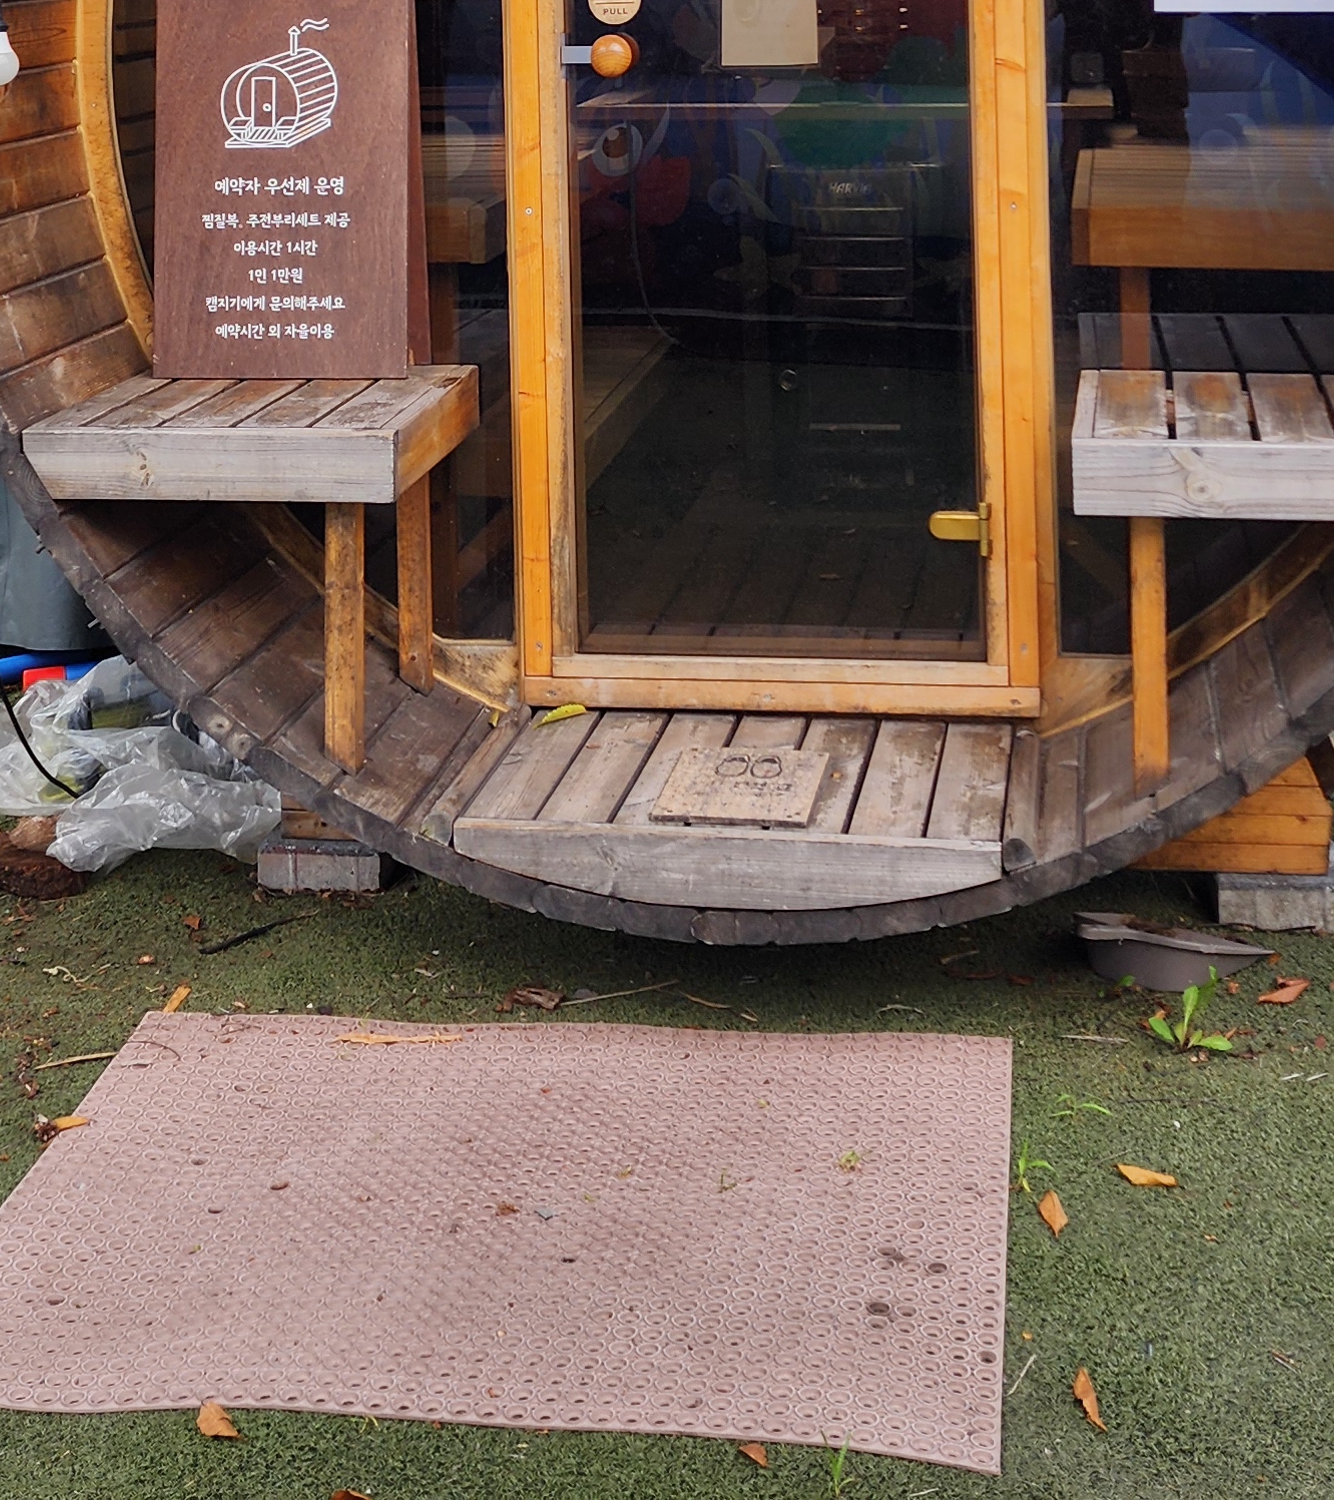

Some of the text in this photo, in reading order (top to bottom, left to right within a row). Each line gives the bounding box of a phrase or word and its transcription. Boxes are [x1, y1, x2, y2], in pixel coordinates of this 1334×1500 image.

[602, 7, 628, 16] PULL
[214, 176, 345, 196] 예약자 우선제 운영
[246, 212, 322, 229] 주전부리세트
[324, 212, 351, 229] 제공
[233, 239, 319, 257] 이용시간 1시간
[248, 267, 303, 284] 1인 1만원
[205, 295, 346, 312] 캠지기에게 문의해주세요
[214, 323, 335, 340] 예약시간 외 자율이용
